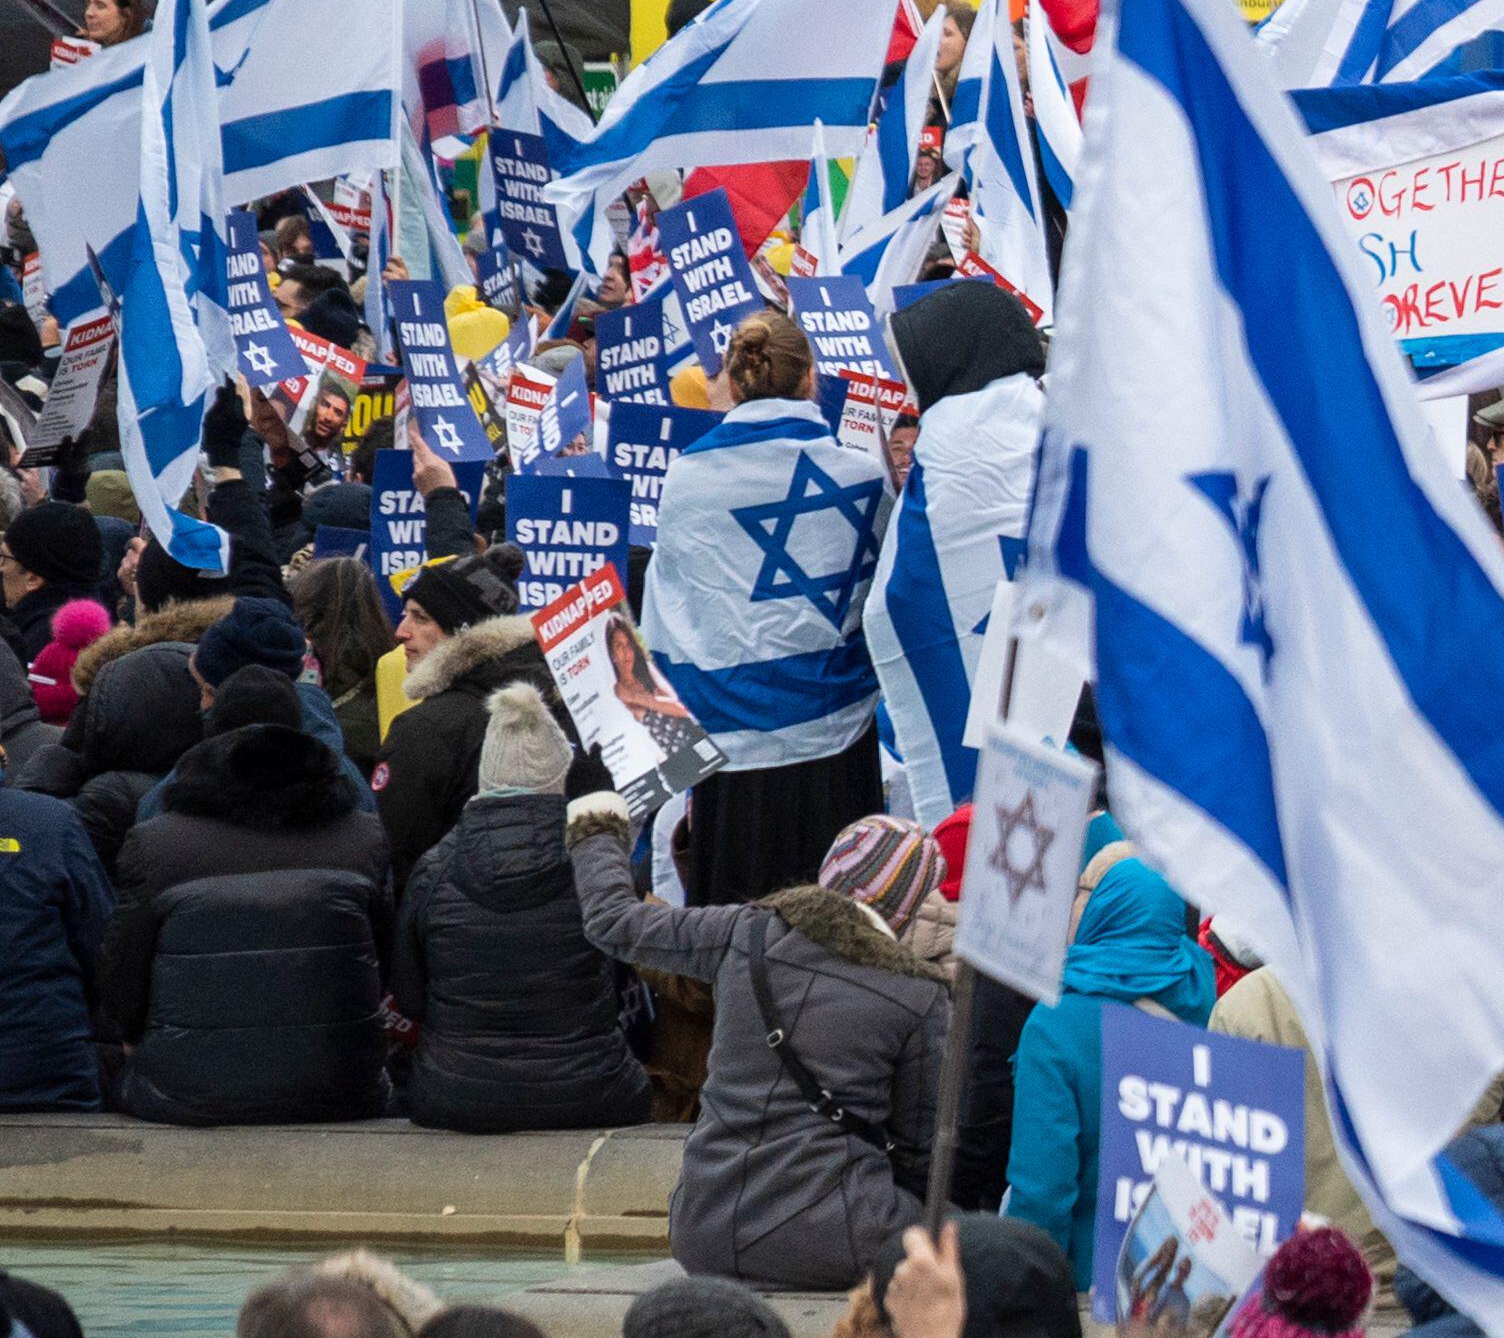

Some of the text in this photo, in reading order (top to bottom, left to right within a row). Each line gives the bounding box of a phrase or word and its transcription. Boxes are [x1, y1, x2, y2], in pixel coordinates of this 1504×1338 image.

[501, 202, 555, 228] ISRAEL
[672, 228, 733, 271] STAND
[683, 260, 735, 294] WITH
[686, 282, 752, 324] ISRAEL
[401, 321, 446, 347] STAND
[801, 310, 871, 334] STAND
[602, 338, 660, 368] STAND
[815, 337, 871, 358] WITH
[410, 352, 448, 377] WITH
[411, 384, 466, 408] ISRAEL
[516, 519, 620, 546] STAND
[538, 579, 614, 643] KIDNAPPED
[1193, 1044, 1212, 1086] I
[1118, 1076, 1288, 1155] STAND
